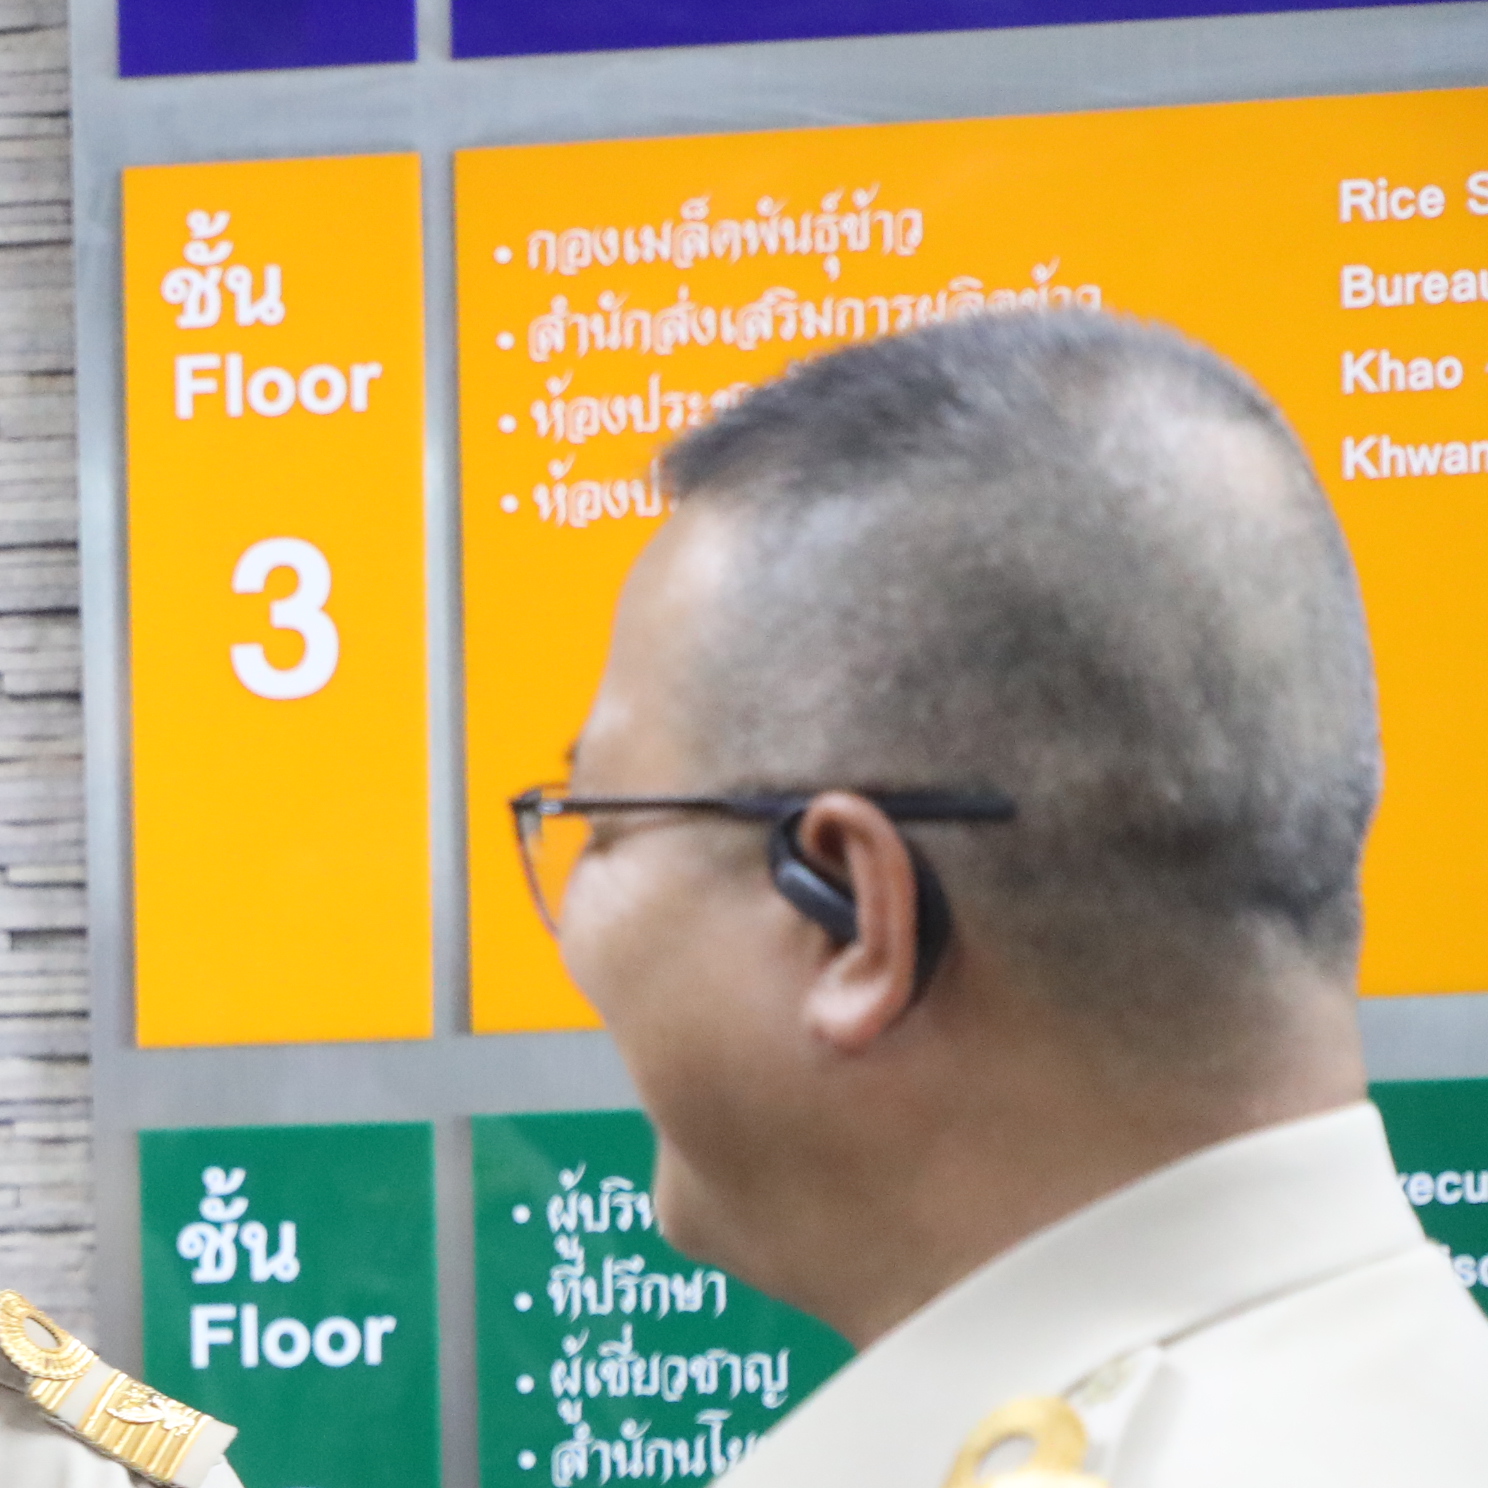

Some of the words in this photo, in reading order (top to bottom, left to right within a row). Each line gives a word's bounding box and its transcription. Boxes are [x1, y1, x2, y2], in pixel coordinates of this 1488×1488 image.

[526, 182, 923, 282] กองเมล็ดพันธุ์ข้าว
[1339, 176, 1445, 223] Rice
[160, 209, 286, 329] ชั้น
[174, 352, 383, 420] Floor
[1341, 348, 1464, 395] Khao
[533, 452, 679, 528] ห้องป
[230, 536, 340, 700] 3
[176, 1165, 301, 1284] ชั้น
[547, 1246, 727, 1322] ที่ปรึกษา
[190, 1303, 397, 1370] Floor
[549, 1321, 791, 1426] ผู้เชี่ยวชาญ
